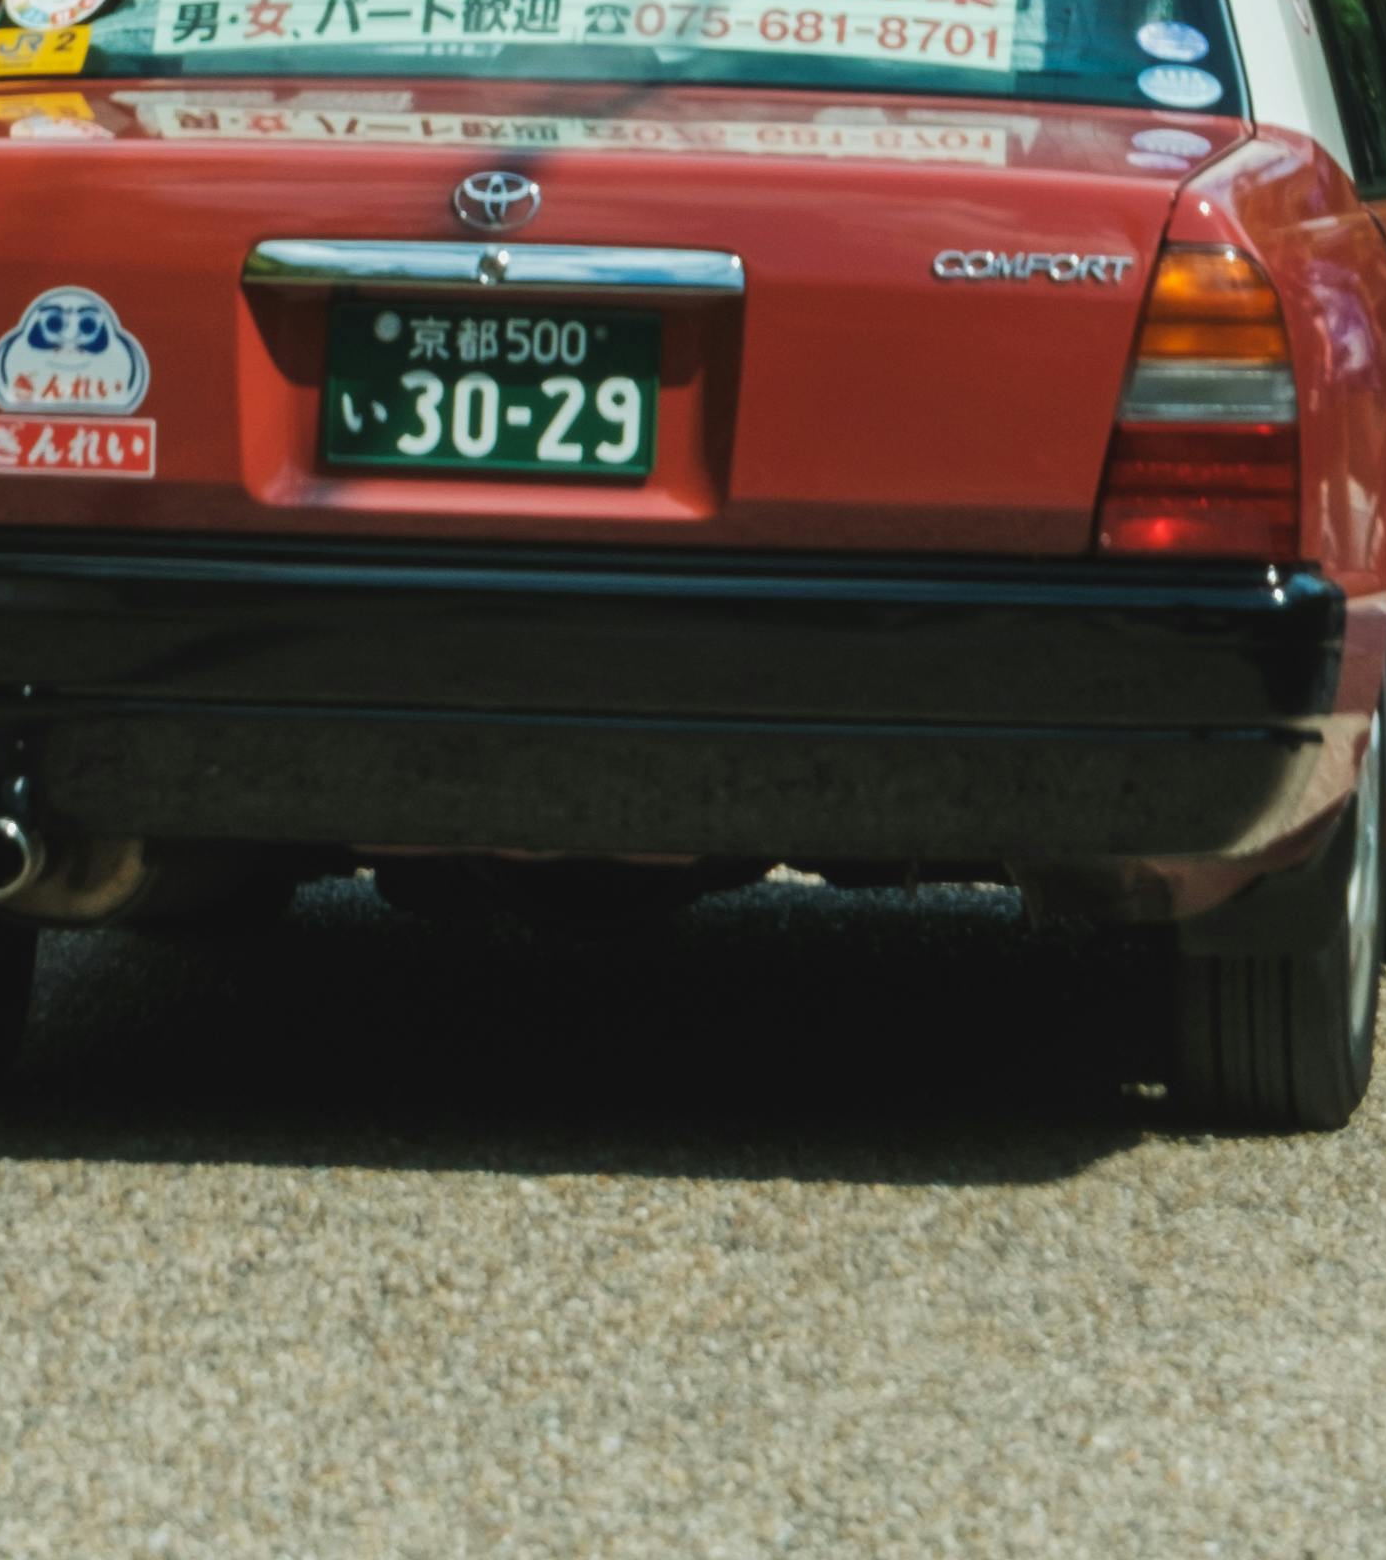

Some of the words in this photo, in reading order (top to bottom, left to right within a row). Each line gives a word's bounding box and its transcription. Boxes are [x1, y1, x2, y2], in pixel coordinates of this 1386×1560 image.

[633, 1, 999, 60] 075-681-8701
[933, 249, 1134, 282] COMFORT
[341, 391, 388, 433] い
[397, 370, 642, 464] 30-29
